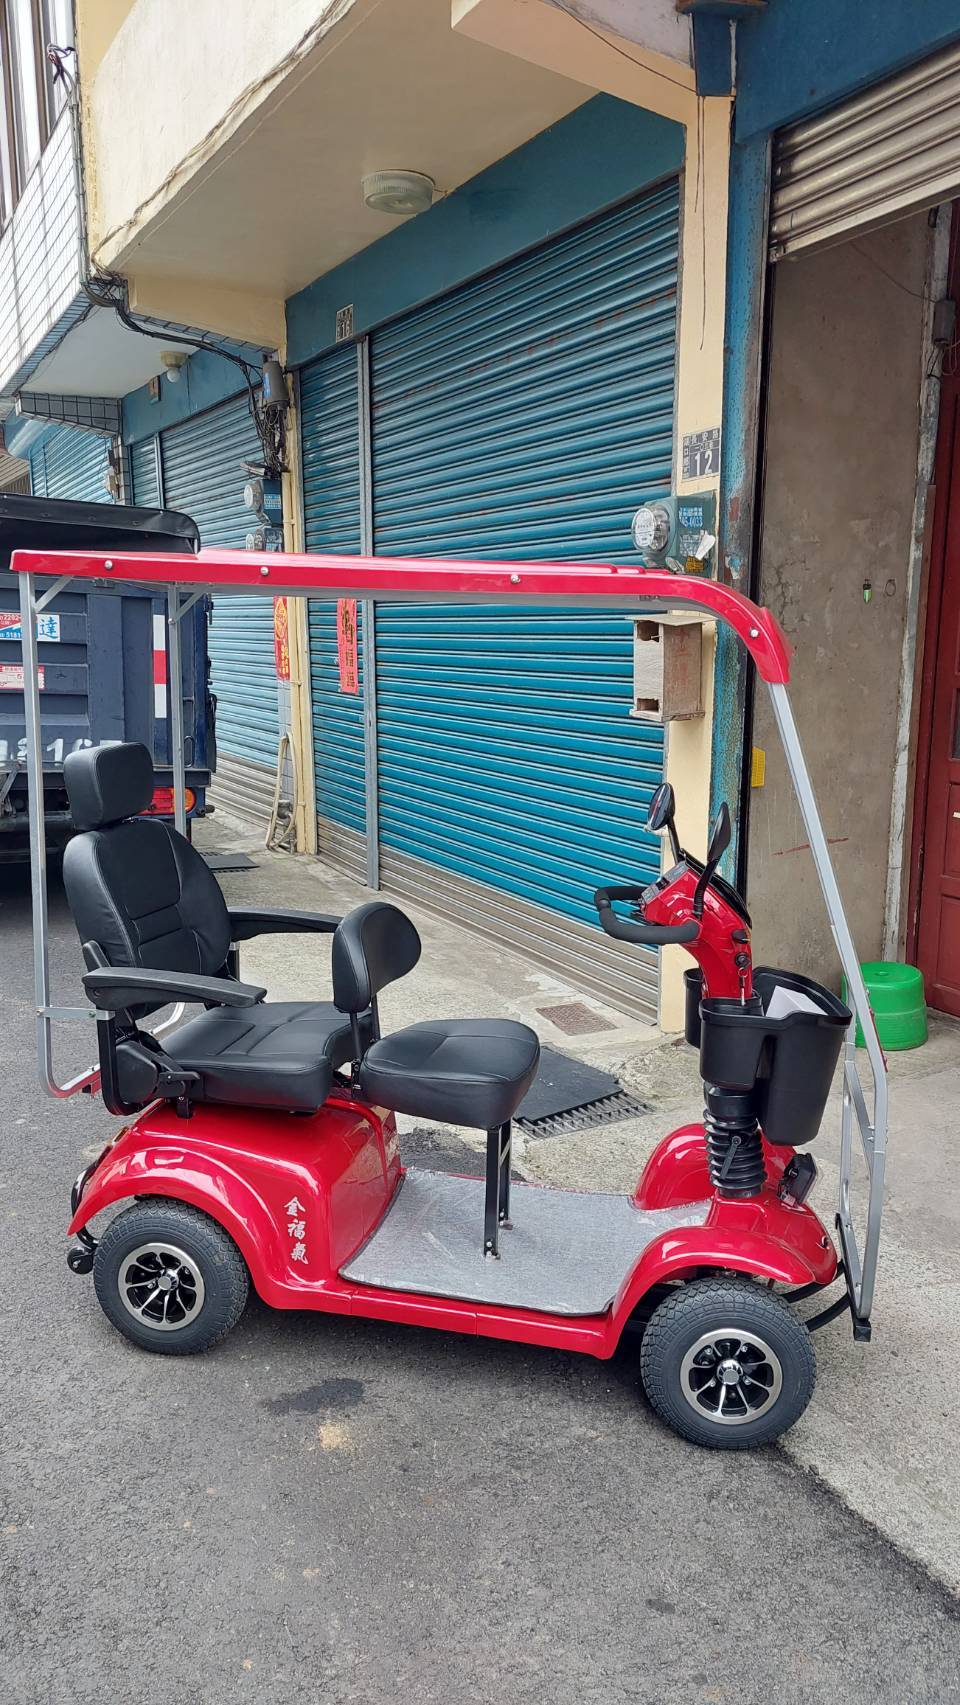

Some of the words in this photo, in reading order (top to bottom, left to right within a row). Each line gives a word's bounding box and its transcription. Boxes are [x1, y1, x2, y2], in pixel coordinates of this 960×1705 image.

[695, 450, 713, 476] 12
[40, 616, 59, 639] 達
[284, 1196, 309, 1264] 金福氣
